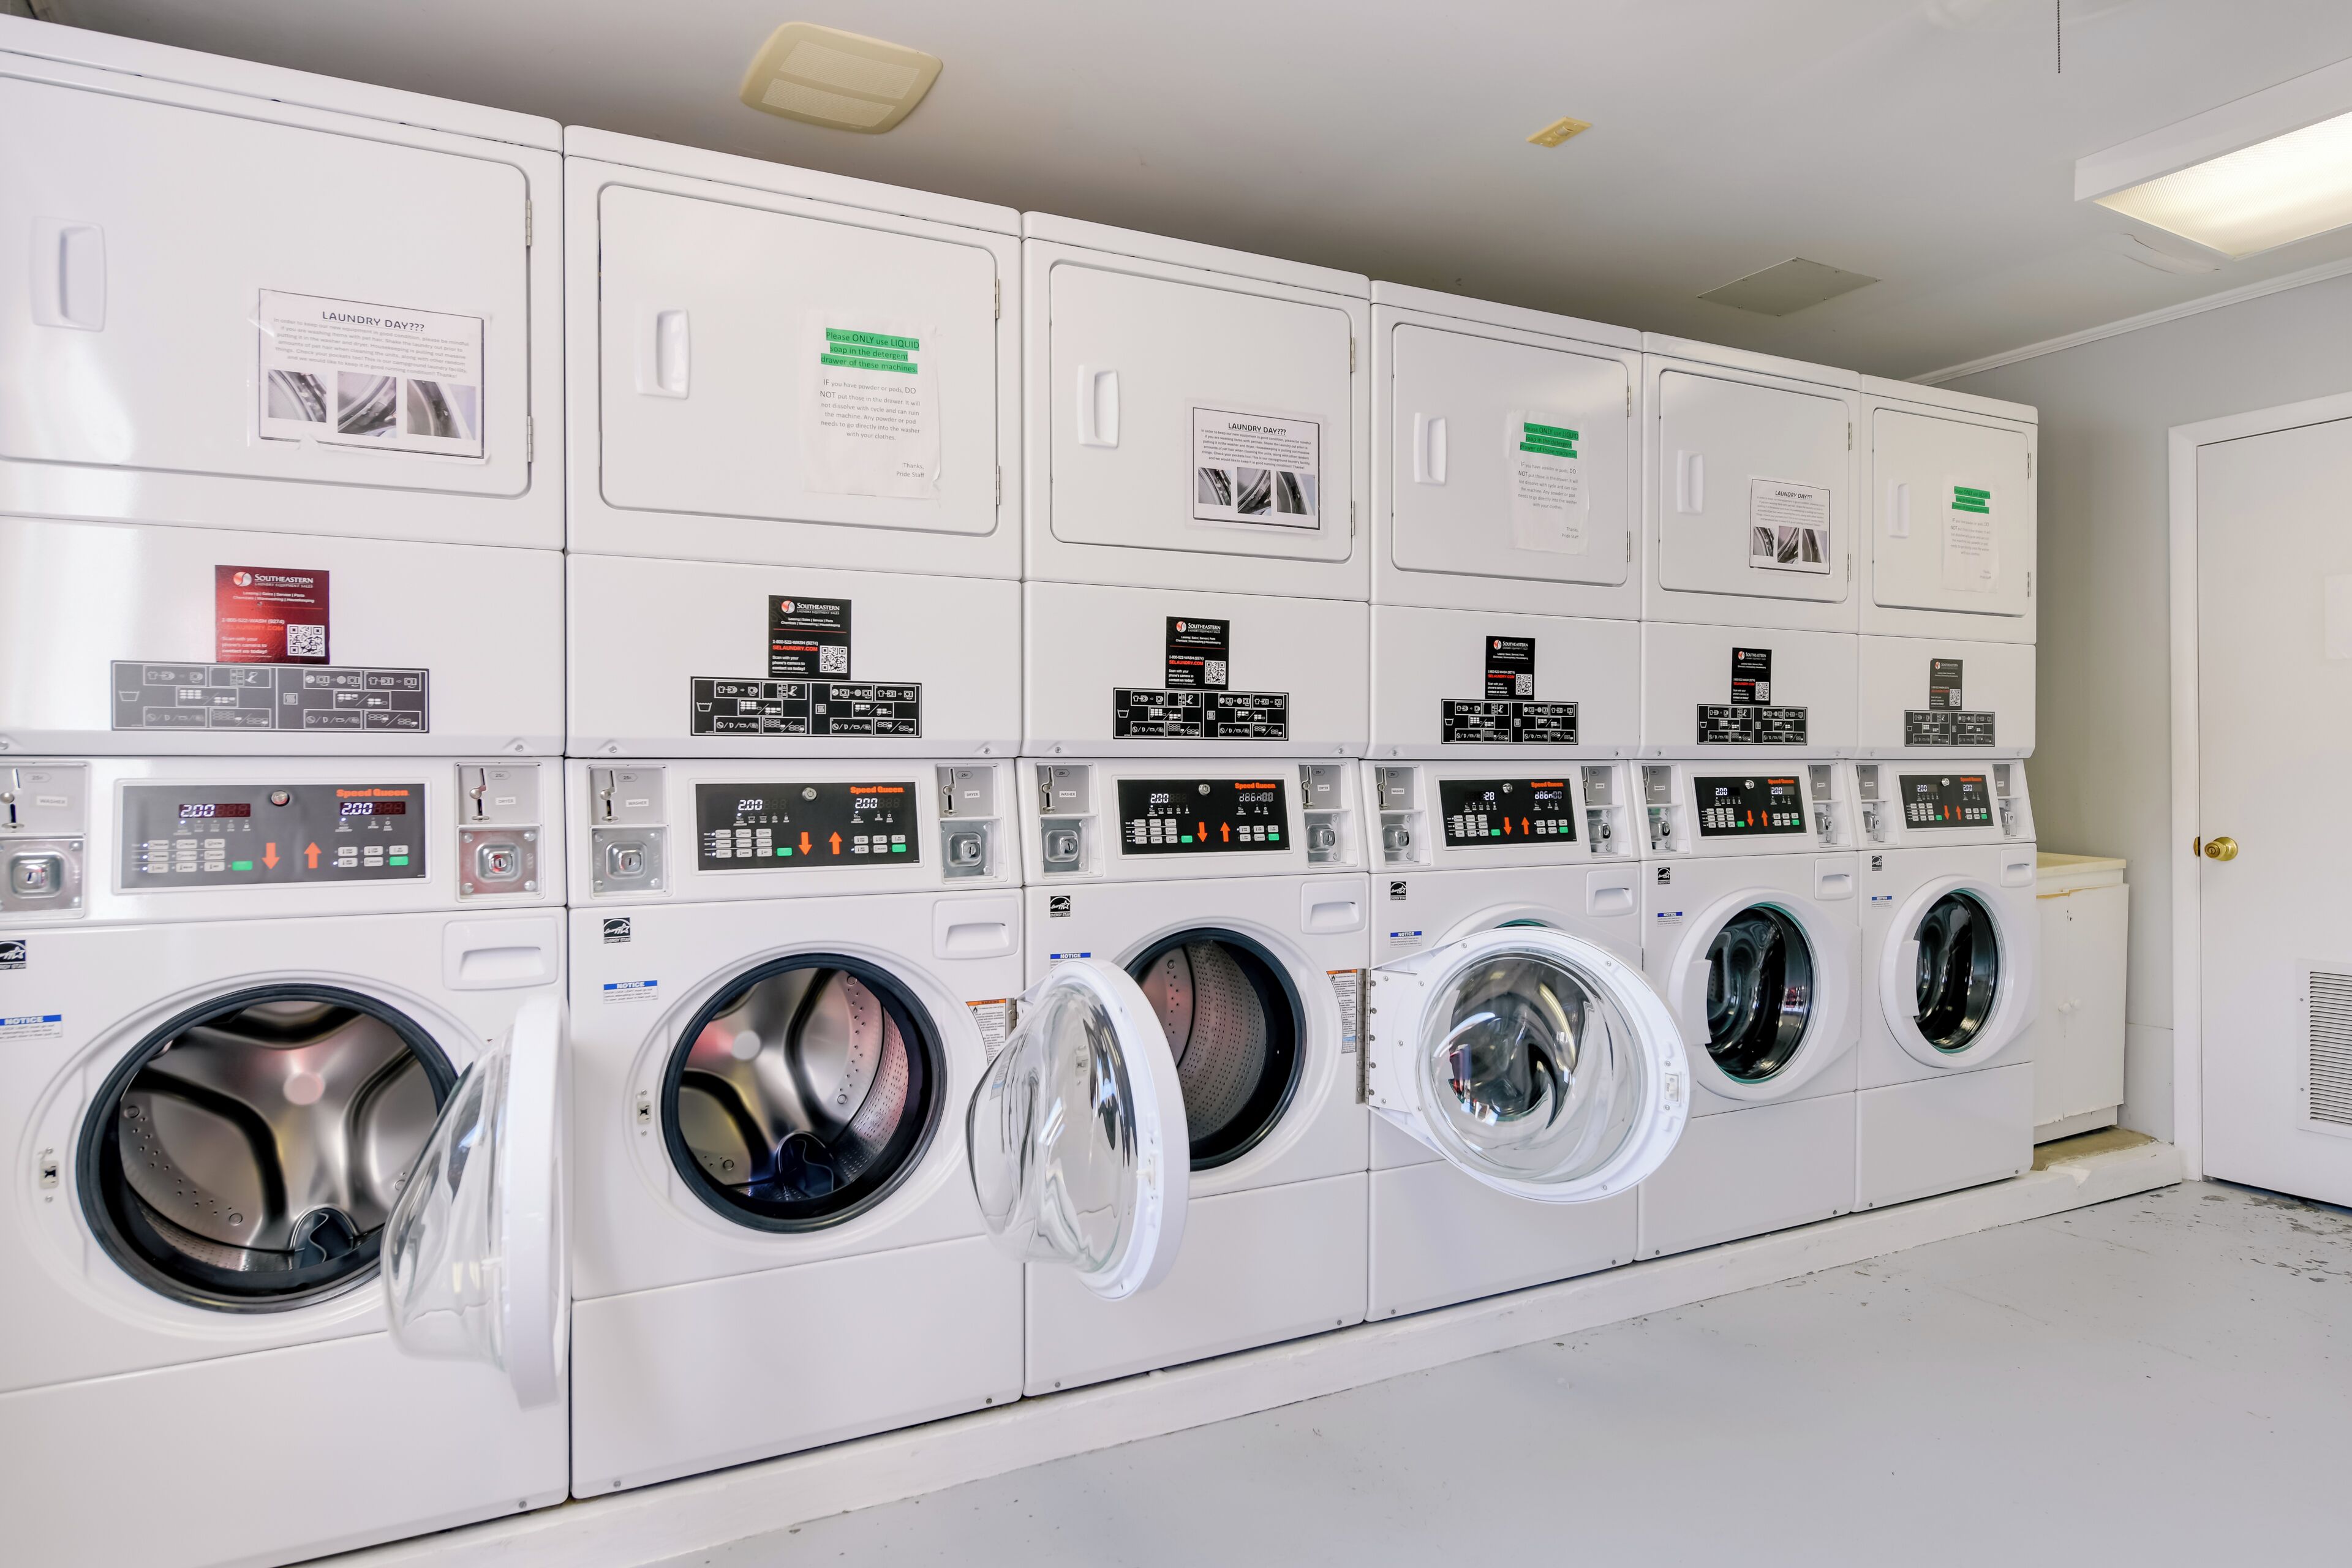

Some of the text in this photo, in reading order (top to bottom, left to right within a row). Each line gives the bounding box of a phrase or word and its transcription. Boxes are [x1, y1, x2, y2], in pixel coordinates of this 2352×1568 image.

[323, 312, 424, 331] LAUNDRY DAY???
[826, 332, 850, 341] Please
[853, 334, 874, 344] ONLY
[891, 339, 919, 349] LIQUID
[830, 346, 847, 355] soap
[873, 350, 908, 360] detergent
[821, 356, 846, 365] drawer
[881, 364, 918, 372] machines.
[1229, 423, 1286, 435] LAUNDRY DAY???
[255, 575, 314, 583] SOUTHEASTERN
[336, 788, 409, 798] Speed Queen
[1150, 794, 1169, 803] 2.00
[855, 798, 878, 809] 2.00
[4, 1016, 44, 1025] NOTICE
